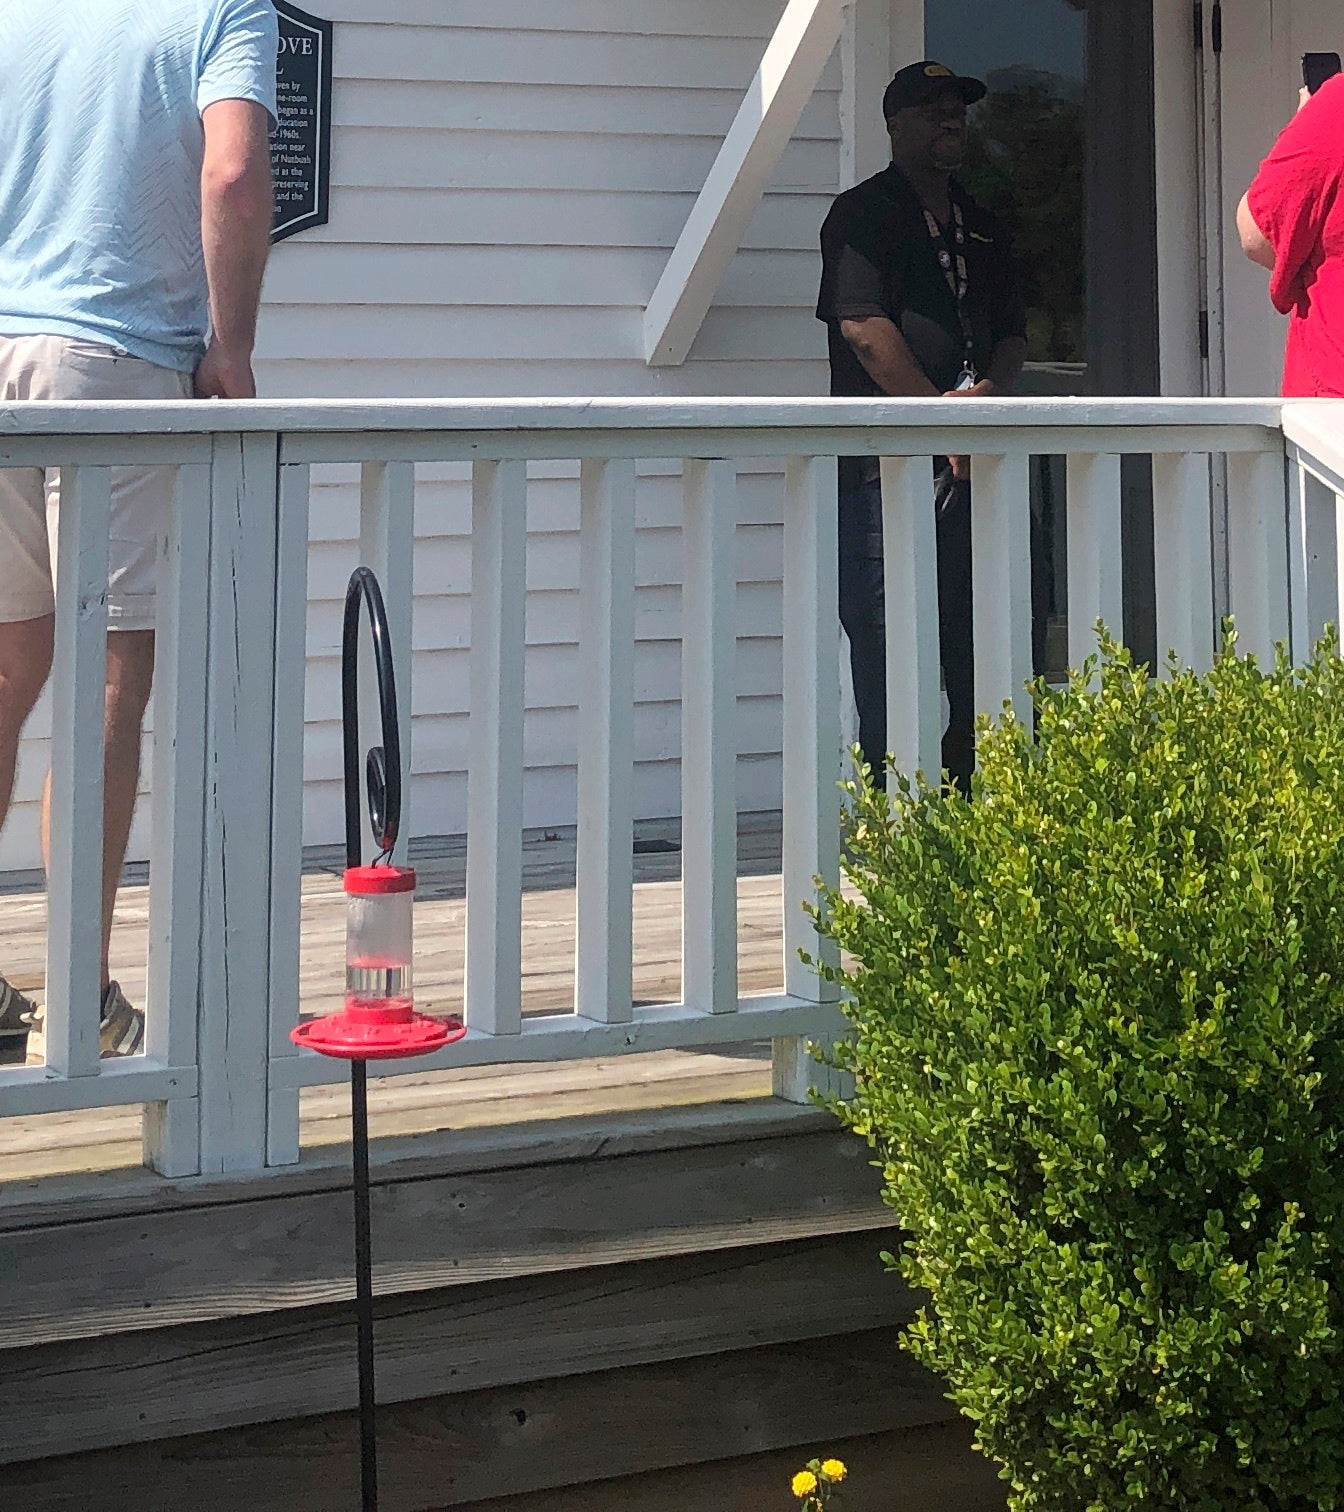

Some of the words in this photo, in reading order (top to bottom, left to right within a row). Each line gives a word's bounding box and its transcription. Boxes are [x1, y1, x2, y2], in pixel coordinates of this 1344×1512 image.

[278, 36, 313, 55] OVE
[278, 118, 309, 127] ducation
[271, 153, 280, 164] of
